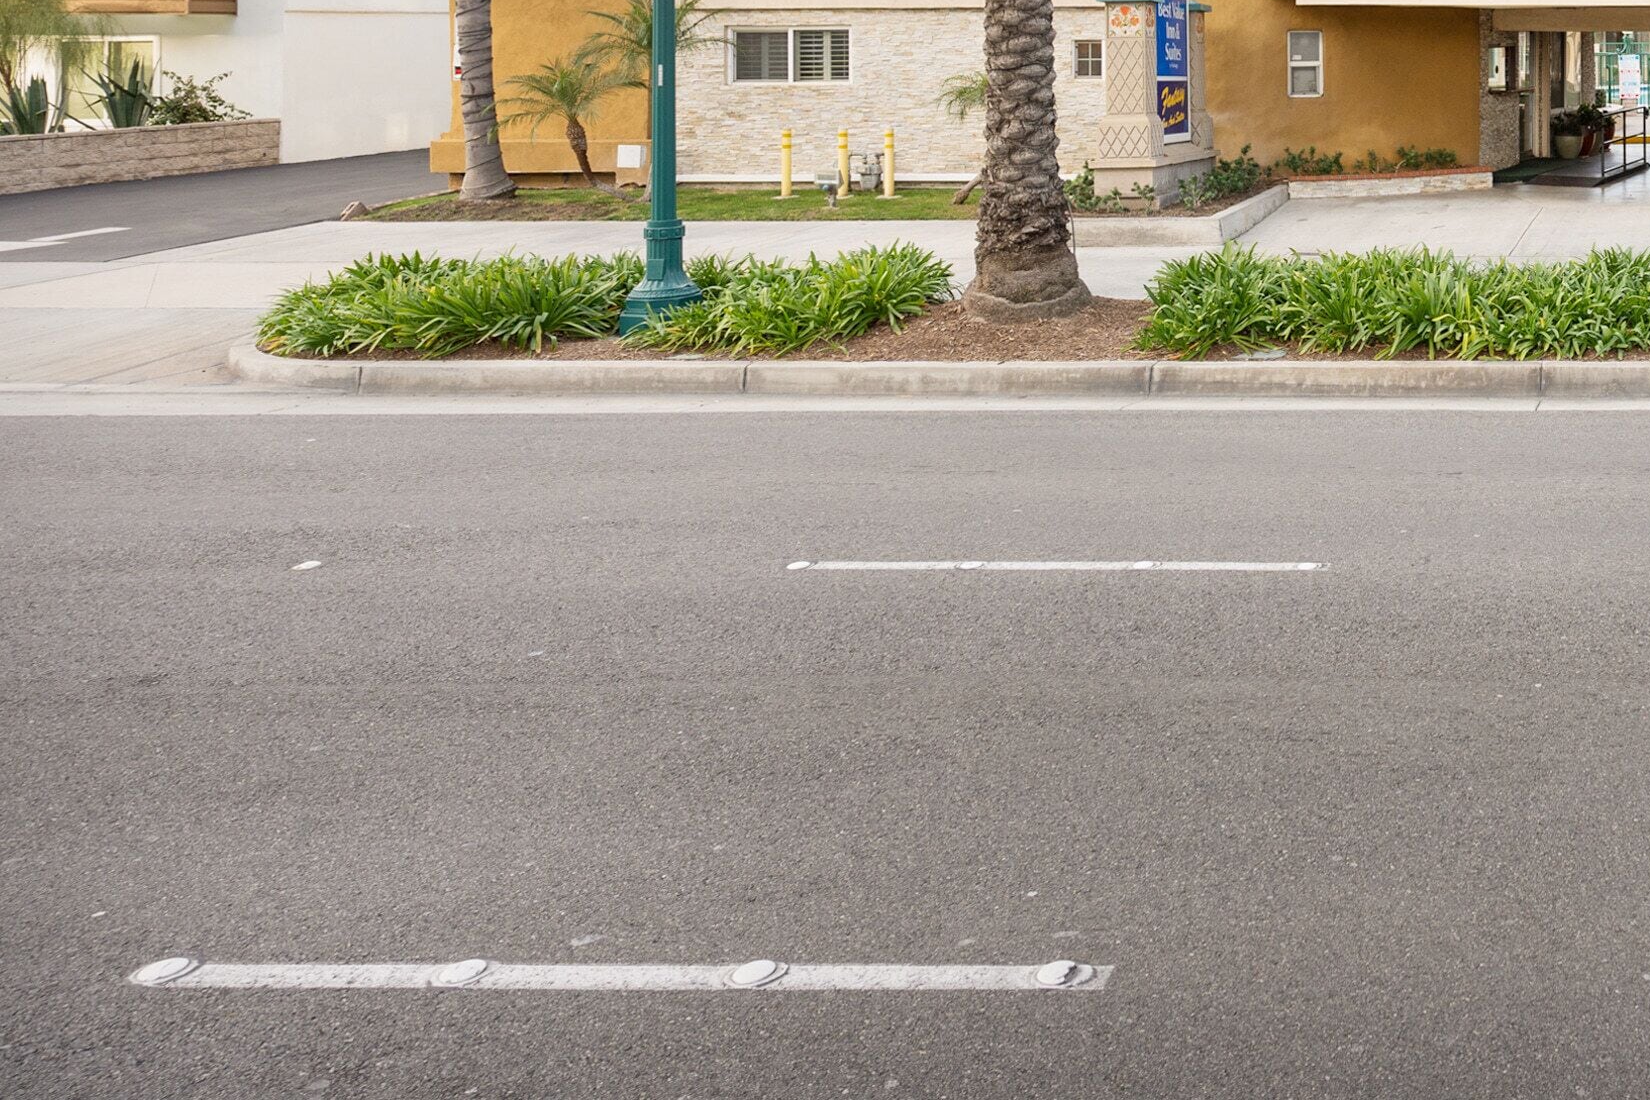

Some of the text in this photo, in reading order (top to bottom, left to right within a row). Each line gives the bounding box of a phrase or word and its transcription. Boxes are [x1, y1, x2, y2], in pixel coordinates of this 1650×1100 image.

[1157, 1, 1185, 20] Best Value
[1165, 21, 1175, 39] Inn
[1164, 42, 1182, 61] Suites
